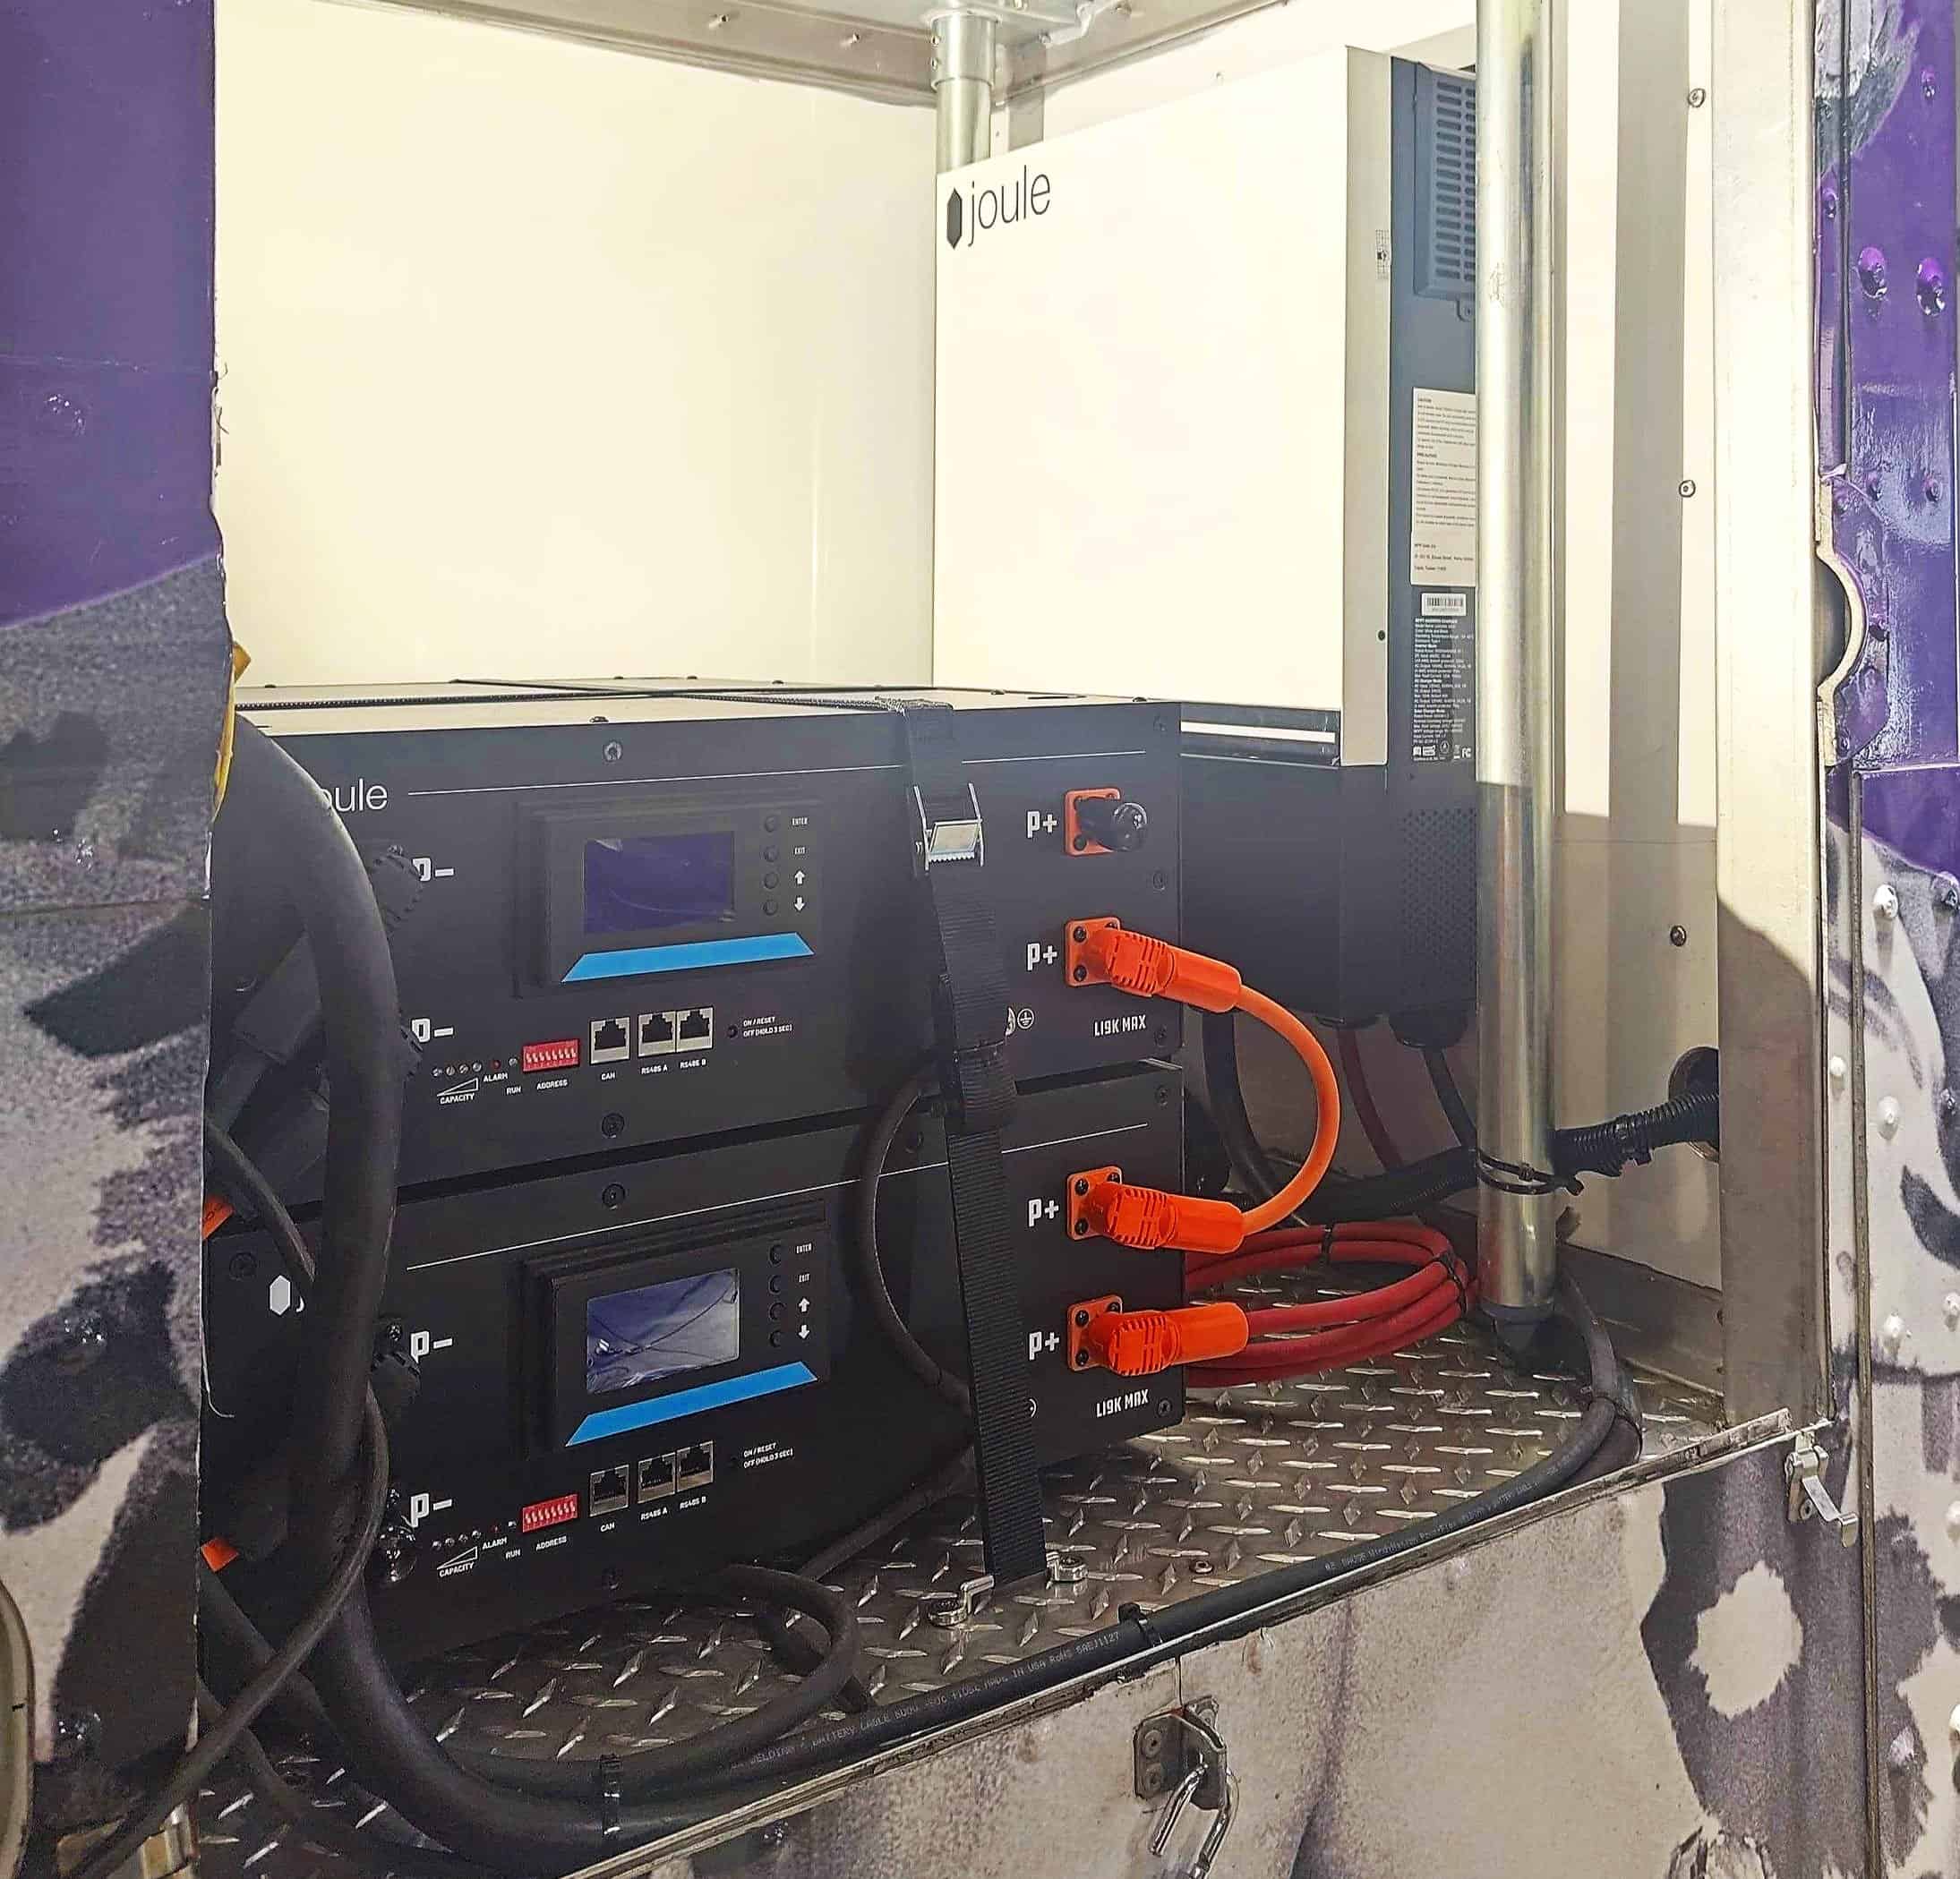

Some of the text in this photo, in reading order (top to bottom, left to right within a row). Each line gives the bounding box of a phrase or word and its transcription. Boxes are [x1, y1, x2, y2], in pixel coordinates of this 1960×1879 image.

[968, 165, 1051, 247] joule
[321, 778, 388, 812] ule
[1026, 810, 1058, 839] P+
[1026, 943, 1058, 971] P+
[1122, 1014, 1147, 1032] MAX
[483, 1072, 509, 1082] ALARM
[601, 1072, 616, 1080] CAN
[506, 1086, 522, 1095] RUN
[536, 1080, 569, 1090] ADDRESS
[440, 1092, 475, 1105] CAPACITY
[1028, 1198, 1059, 1227] P+
[1029, 1330, 1060, 1362] P+
[1124, 1388, 1150, 1411] MAX
[411, 1492, 453, 1528] P-
[600, 1522, 616, 1533] CAN
[482, 1536, 508, 1550] ALARM
[535, 1535, 568, 1551] ADDRESS
[505, 1549, 521, 1559] RUN
[439, 1561, 475, 1577] CAPACITY
